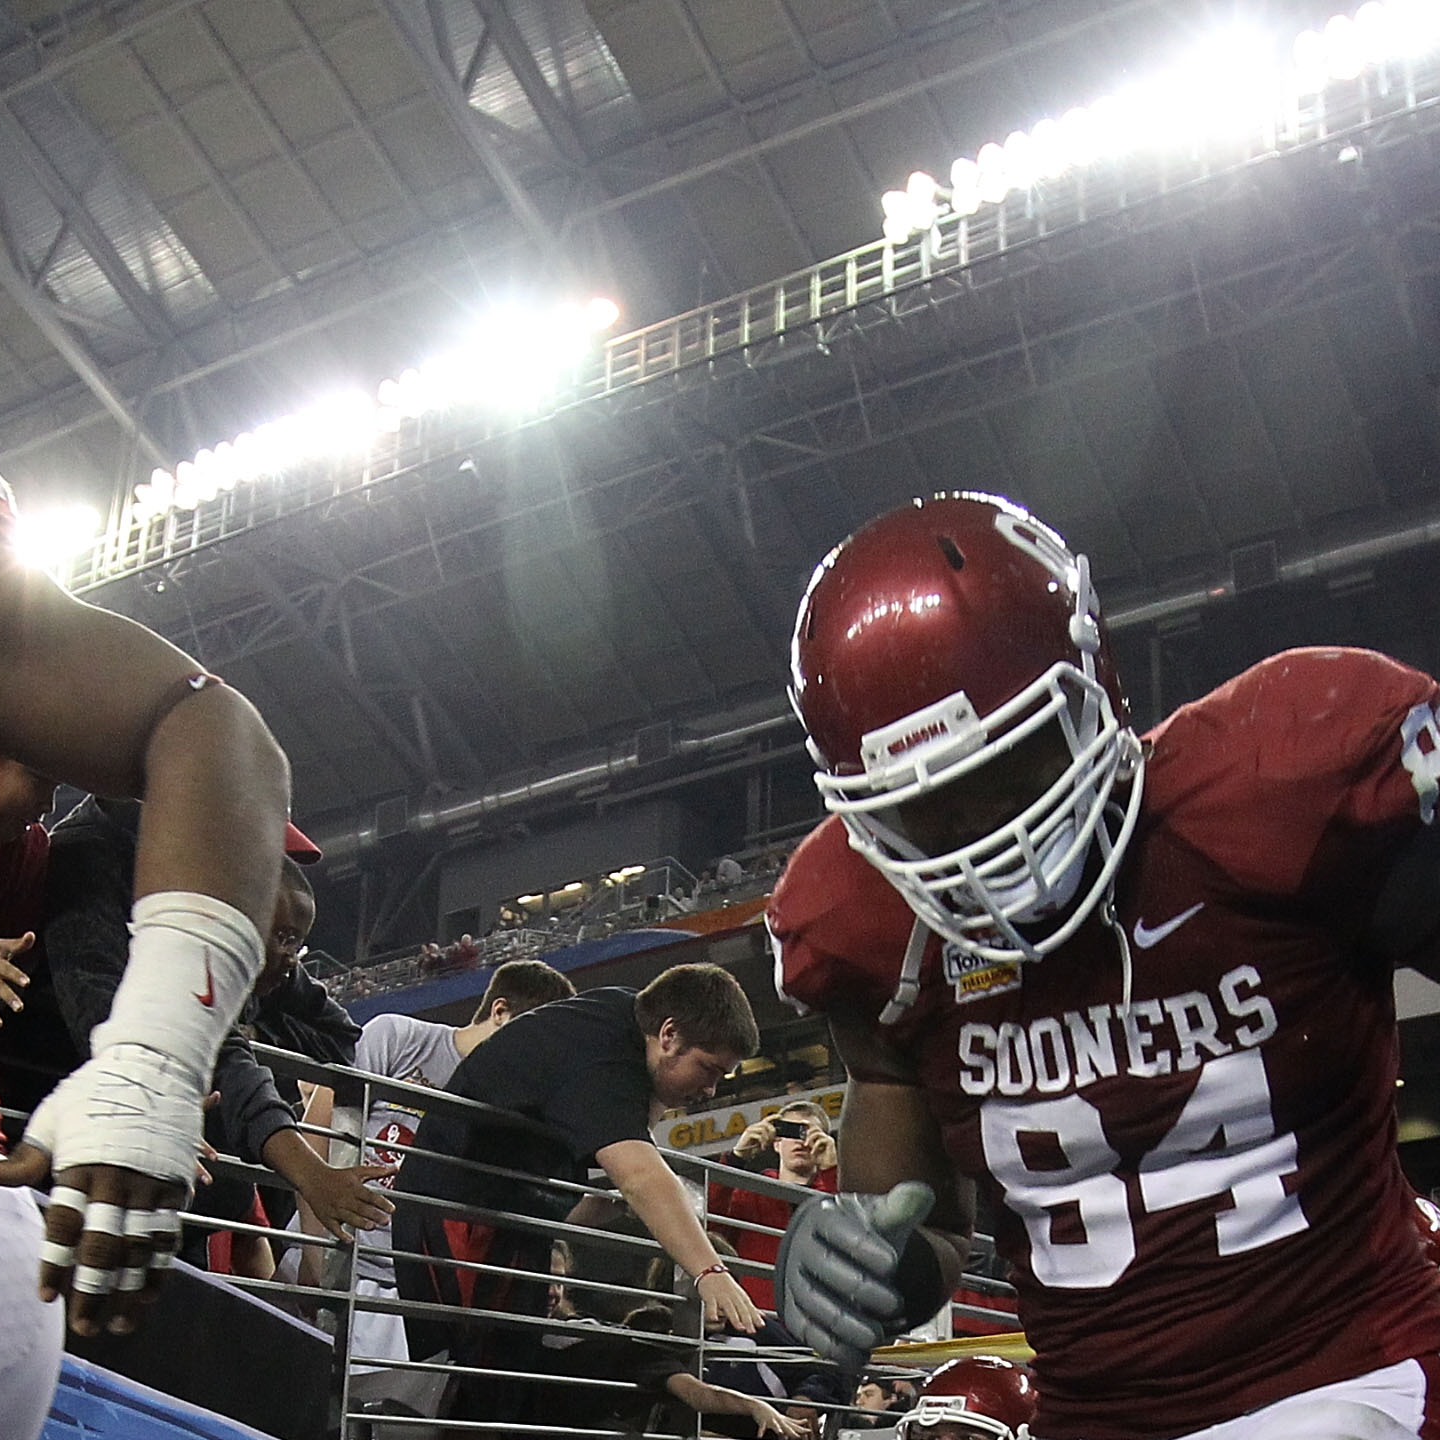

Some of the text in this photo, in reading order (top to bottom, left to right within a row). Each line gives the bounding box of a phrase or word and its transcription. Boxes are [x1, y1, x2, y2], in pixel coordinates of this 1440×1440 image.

[959, 964, 1279, 1096] SOONERS
[668, 1112, 748, 1149] GILA
[981, 1048, 1311, 1290] 84
